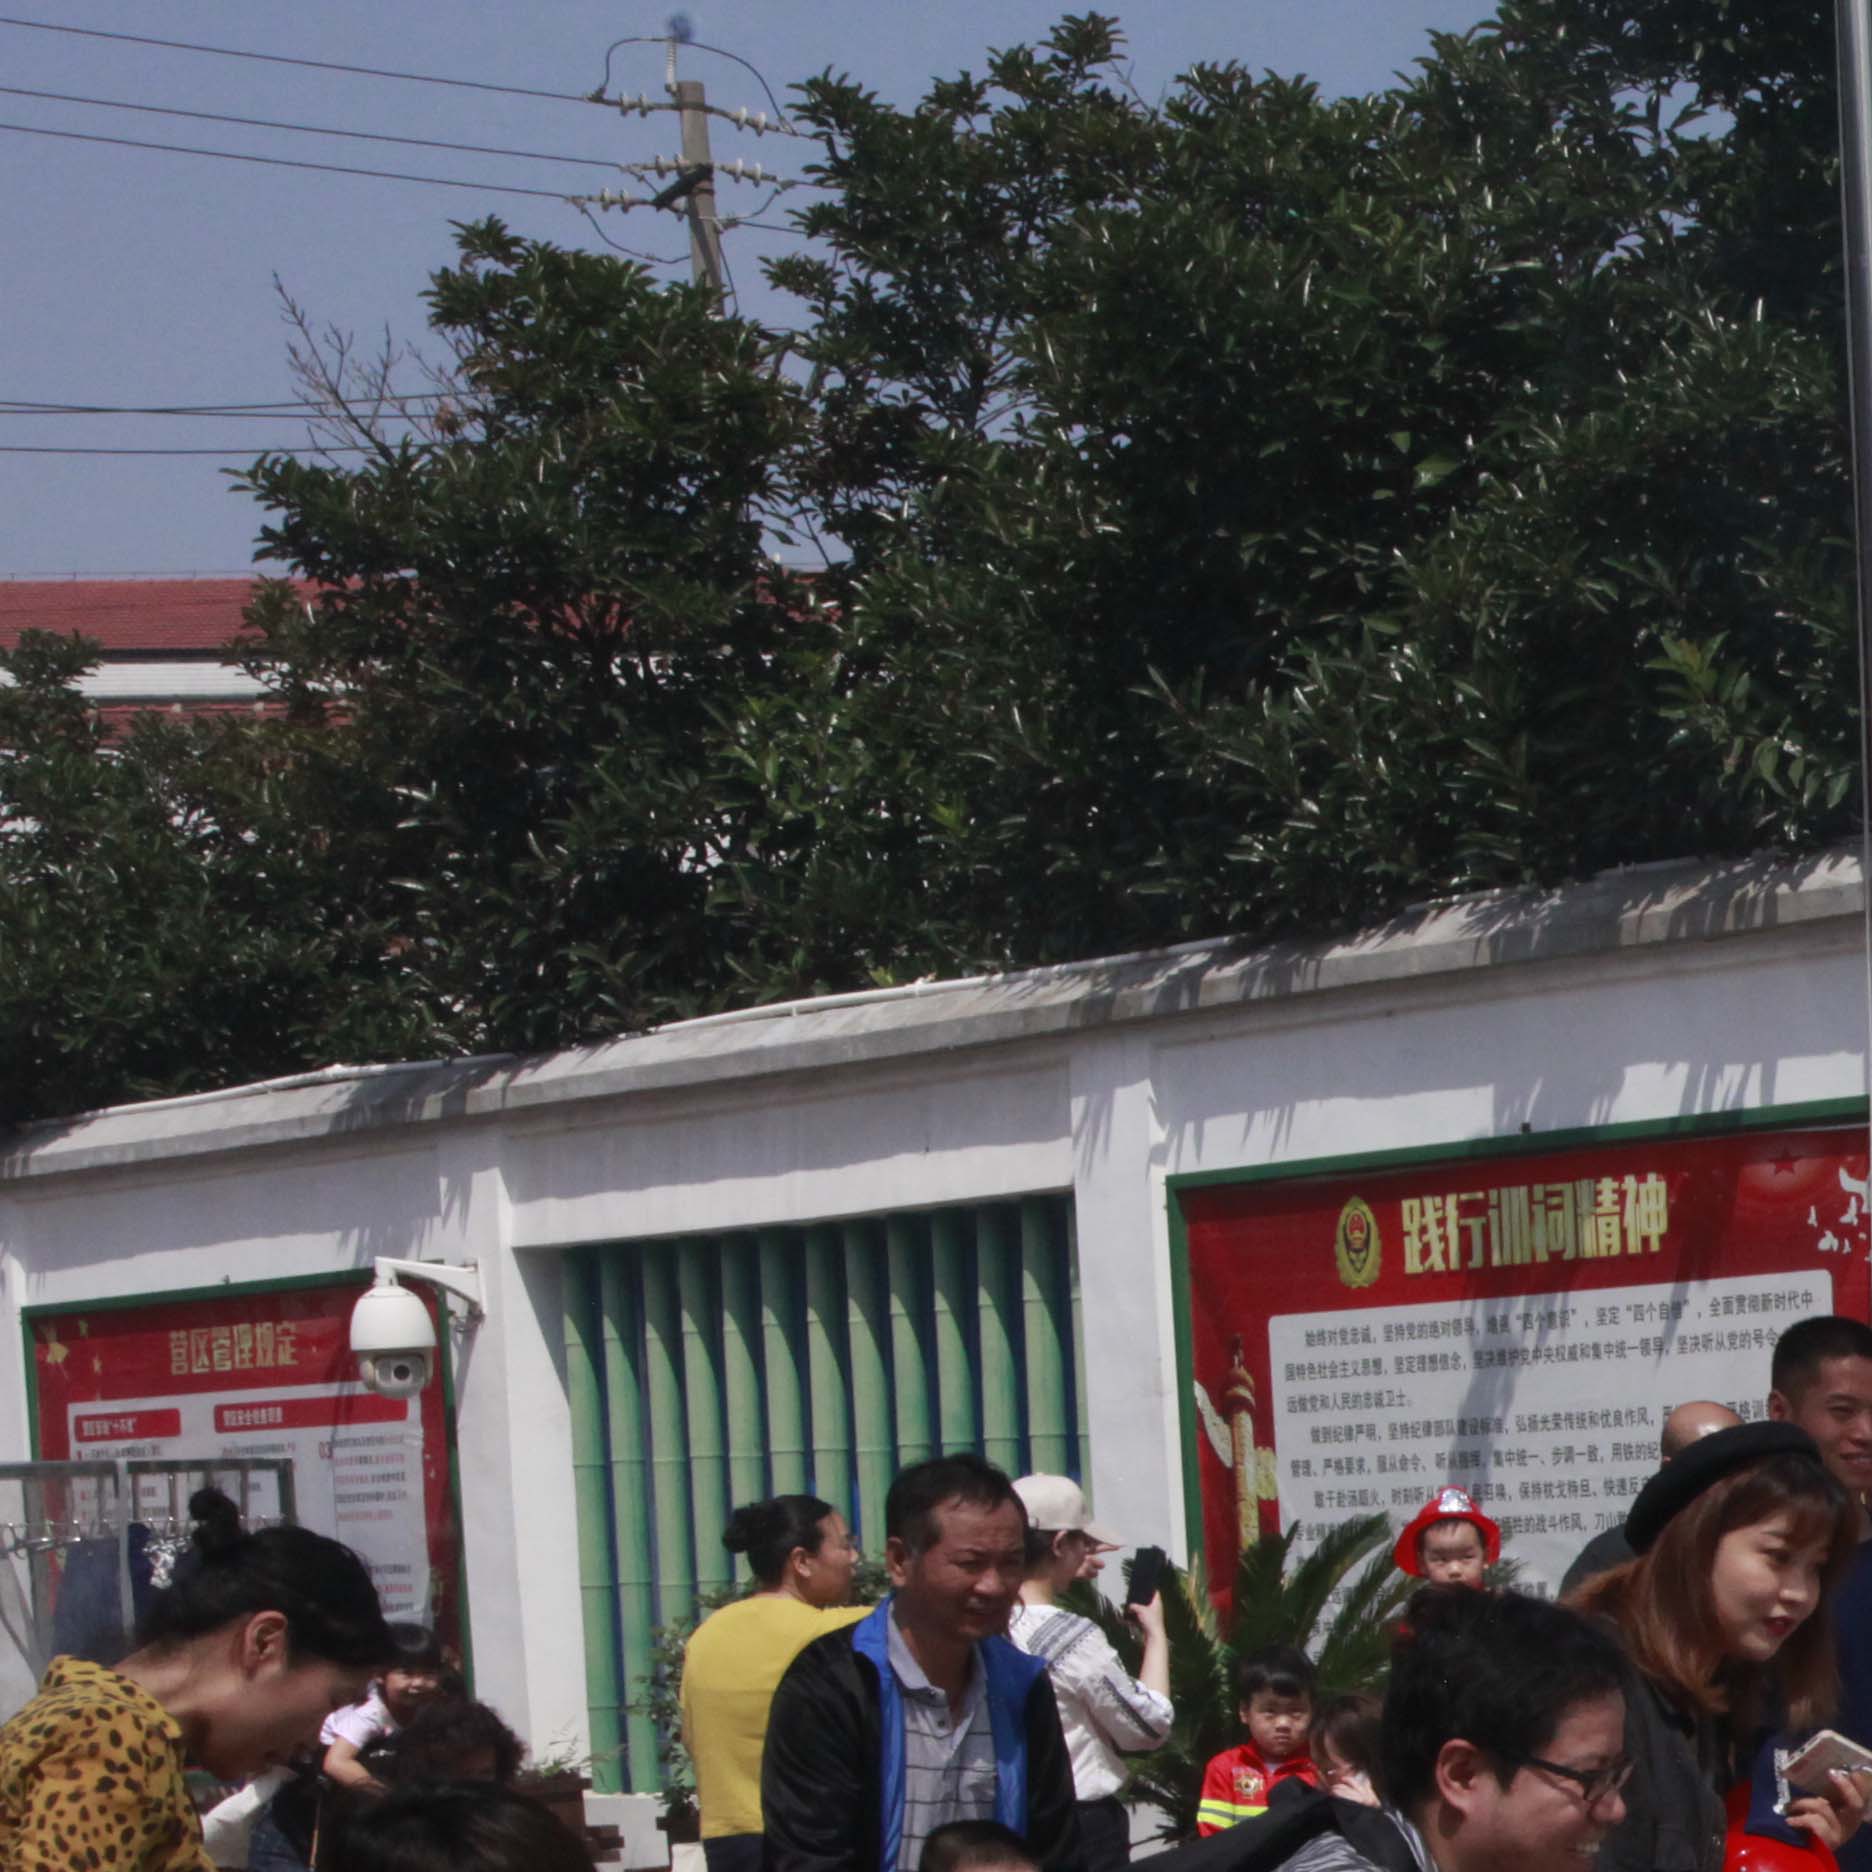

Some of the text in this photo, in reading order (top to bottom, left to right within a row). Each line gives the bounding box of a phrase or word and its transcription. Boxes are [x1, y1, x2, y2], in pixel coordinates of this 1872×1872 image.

[1401, 1172, 1670, 1275] 践行训词精神
[169, 1320, 299, 1376] 营区管理规定
